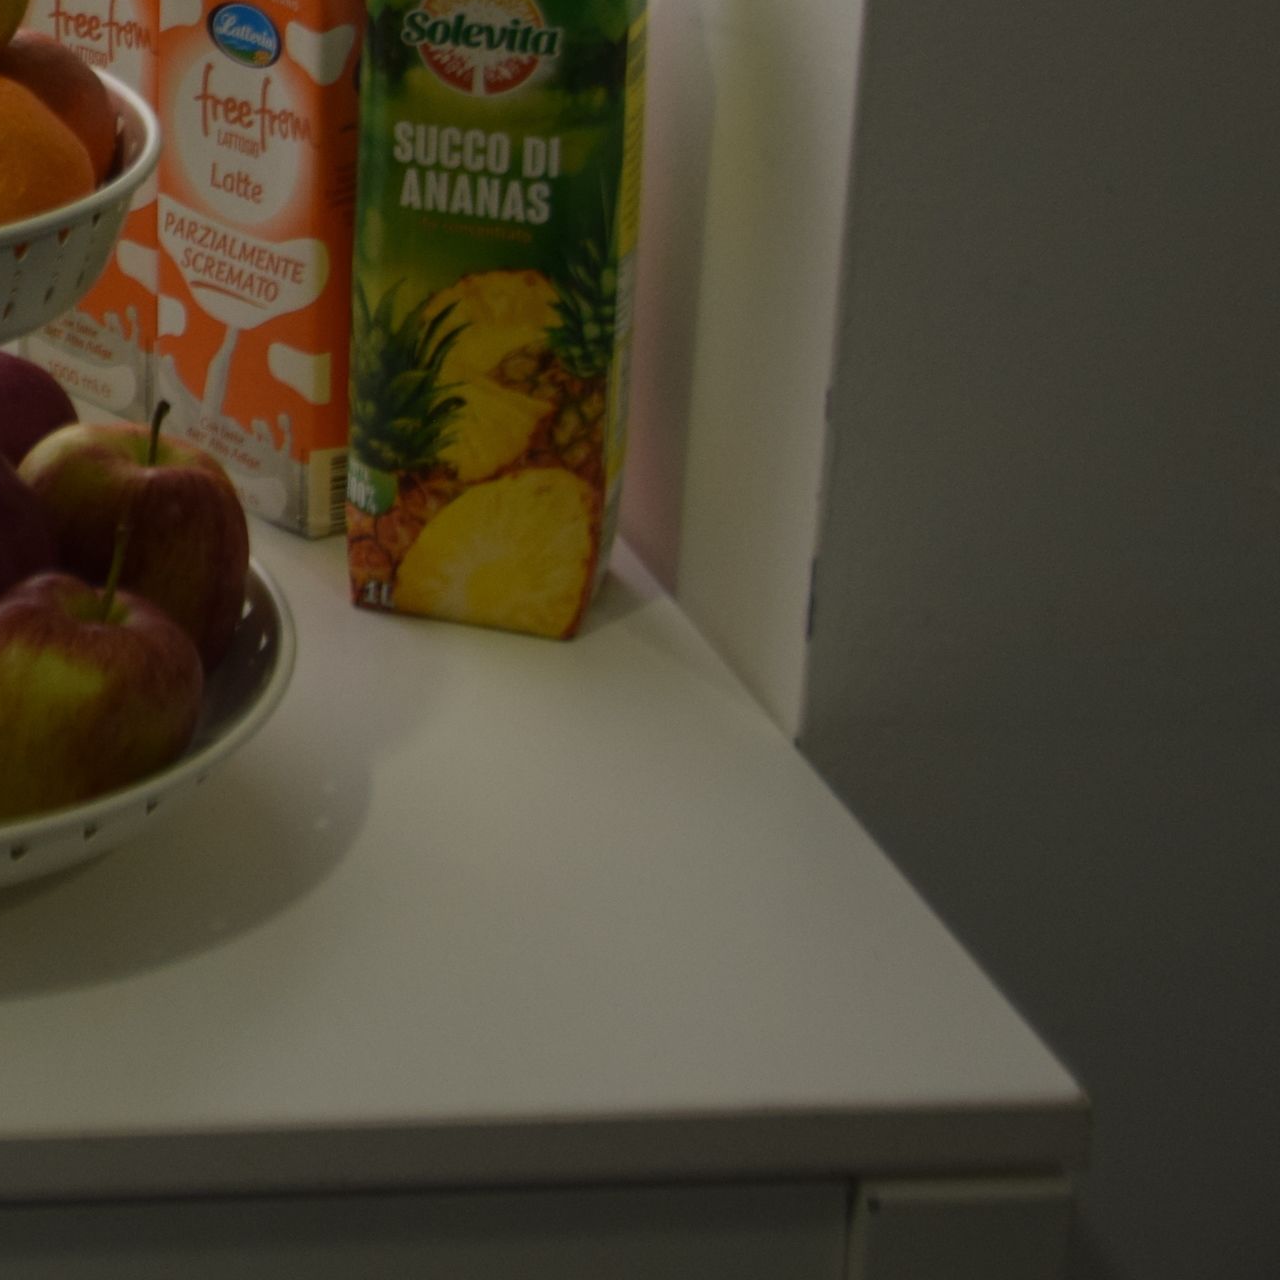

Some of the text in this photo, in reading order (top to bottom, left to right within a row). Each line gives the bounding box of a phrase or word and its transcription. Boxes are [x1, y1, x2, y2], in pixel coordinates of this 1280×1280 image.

[402, 10, 559, 56] Solevita
[392, 120, 562, 179] SUCCO DI
[211, 162, 263, 204] Latte
[399, 167, 552, 225] ANANAS
[164, 212, 305, 285] PARZIALMENTE
[181, 247, 280, 303] SCREMATO
